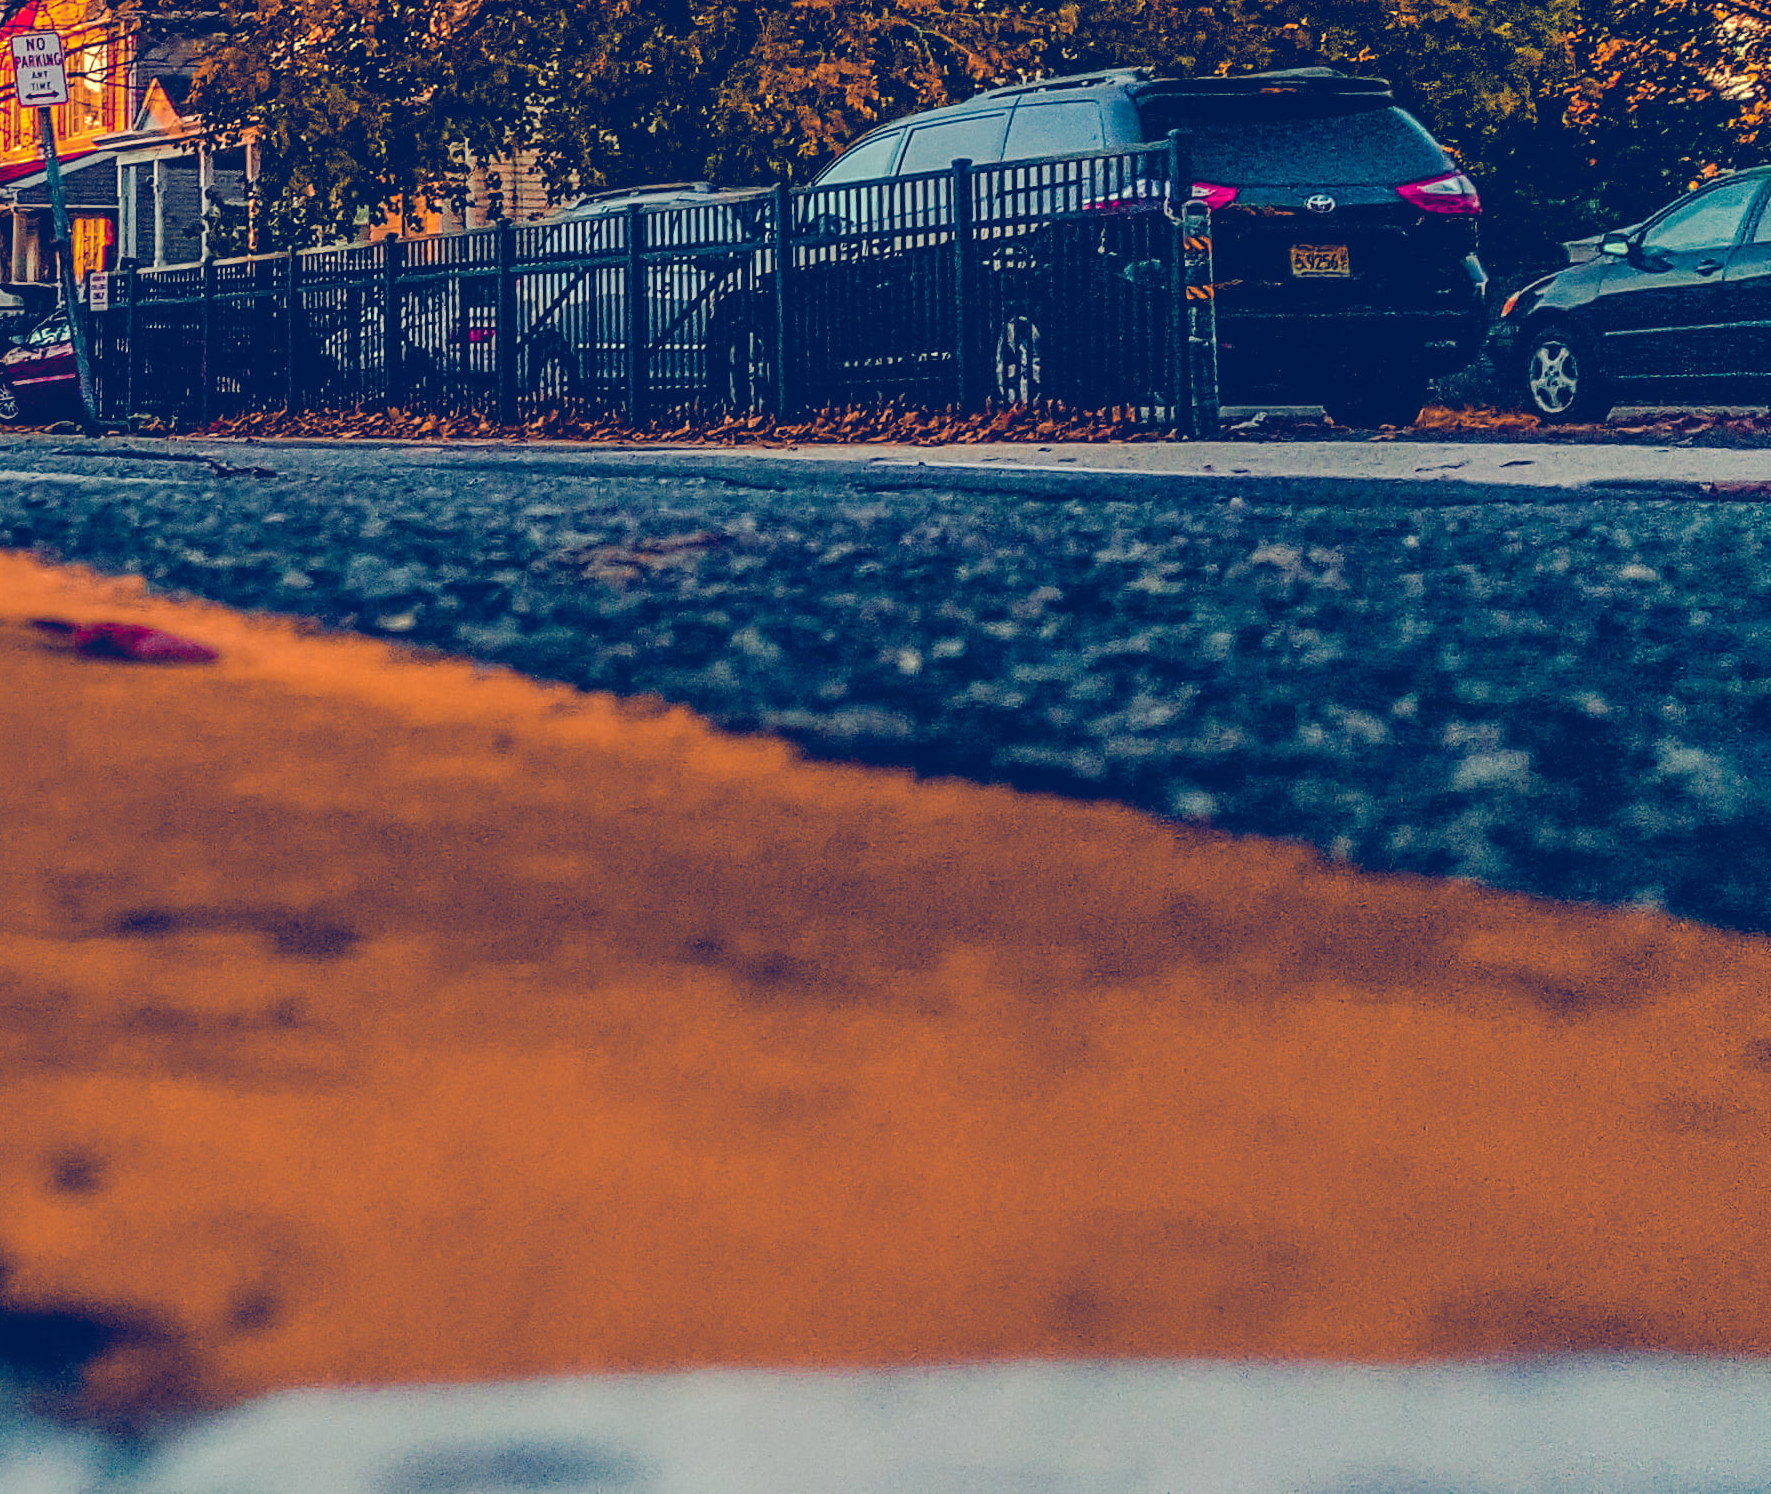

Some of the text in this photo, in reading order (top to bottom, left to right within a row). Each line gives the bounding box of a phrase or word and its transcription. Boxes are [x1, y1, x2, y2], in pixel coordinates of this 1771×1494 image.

[25, 37, 46, 51] NO
[14, 52, 62, 68] PARKING
[31, 81, 51, 91] TIME
